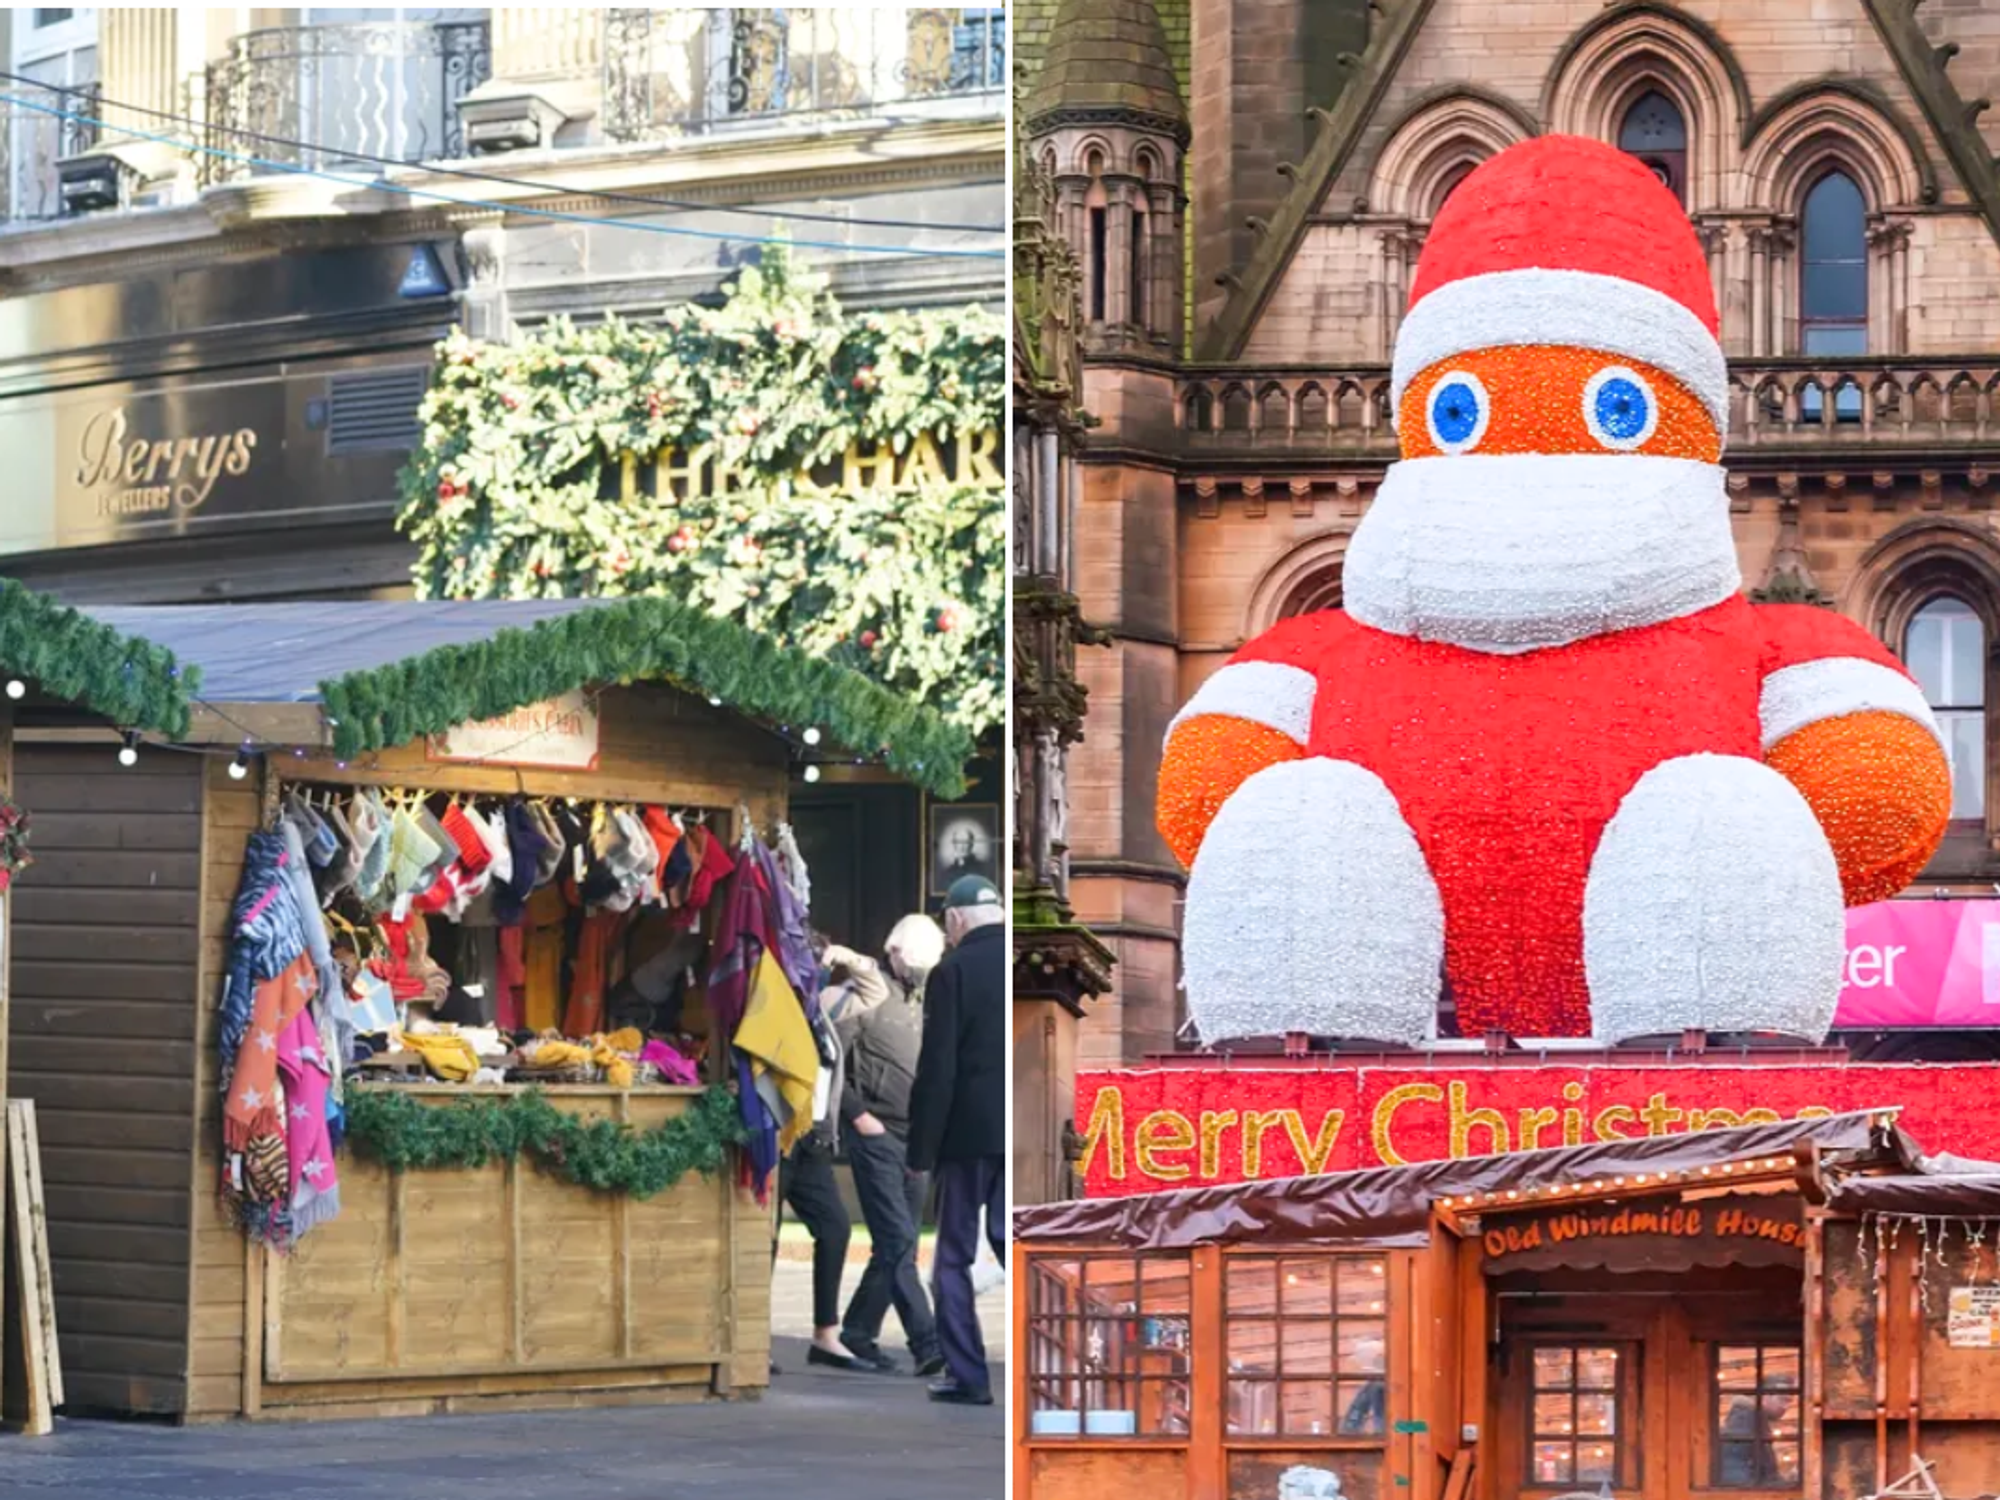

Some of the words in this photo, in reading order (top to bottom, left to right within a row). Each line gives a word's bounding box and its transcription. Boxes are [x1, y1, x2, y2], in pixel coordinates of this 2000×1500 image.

[77, 406, 257, 508] Berrys
[1484, 1221, 1541, 1257] Old
[1549, 1205, 1702, 1243] Windmill
